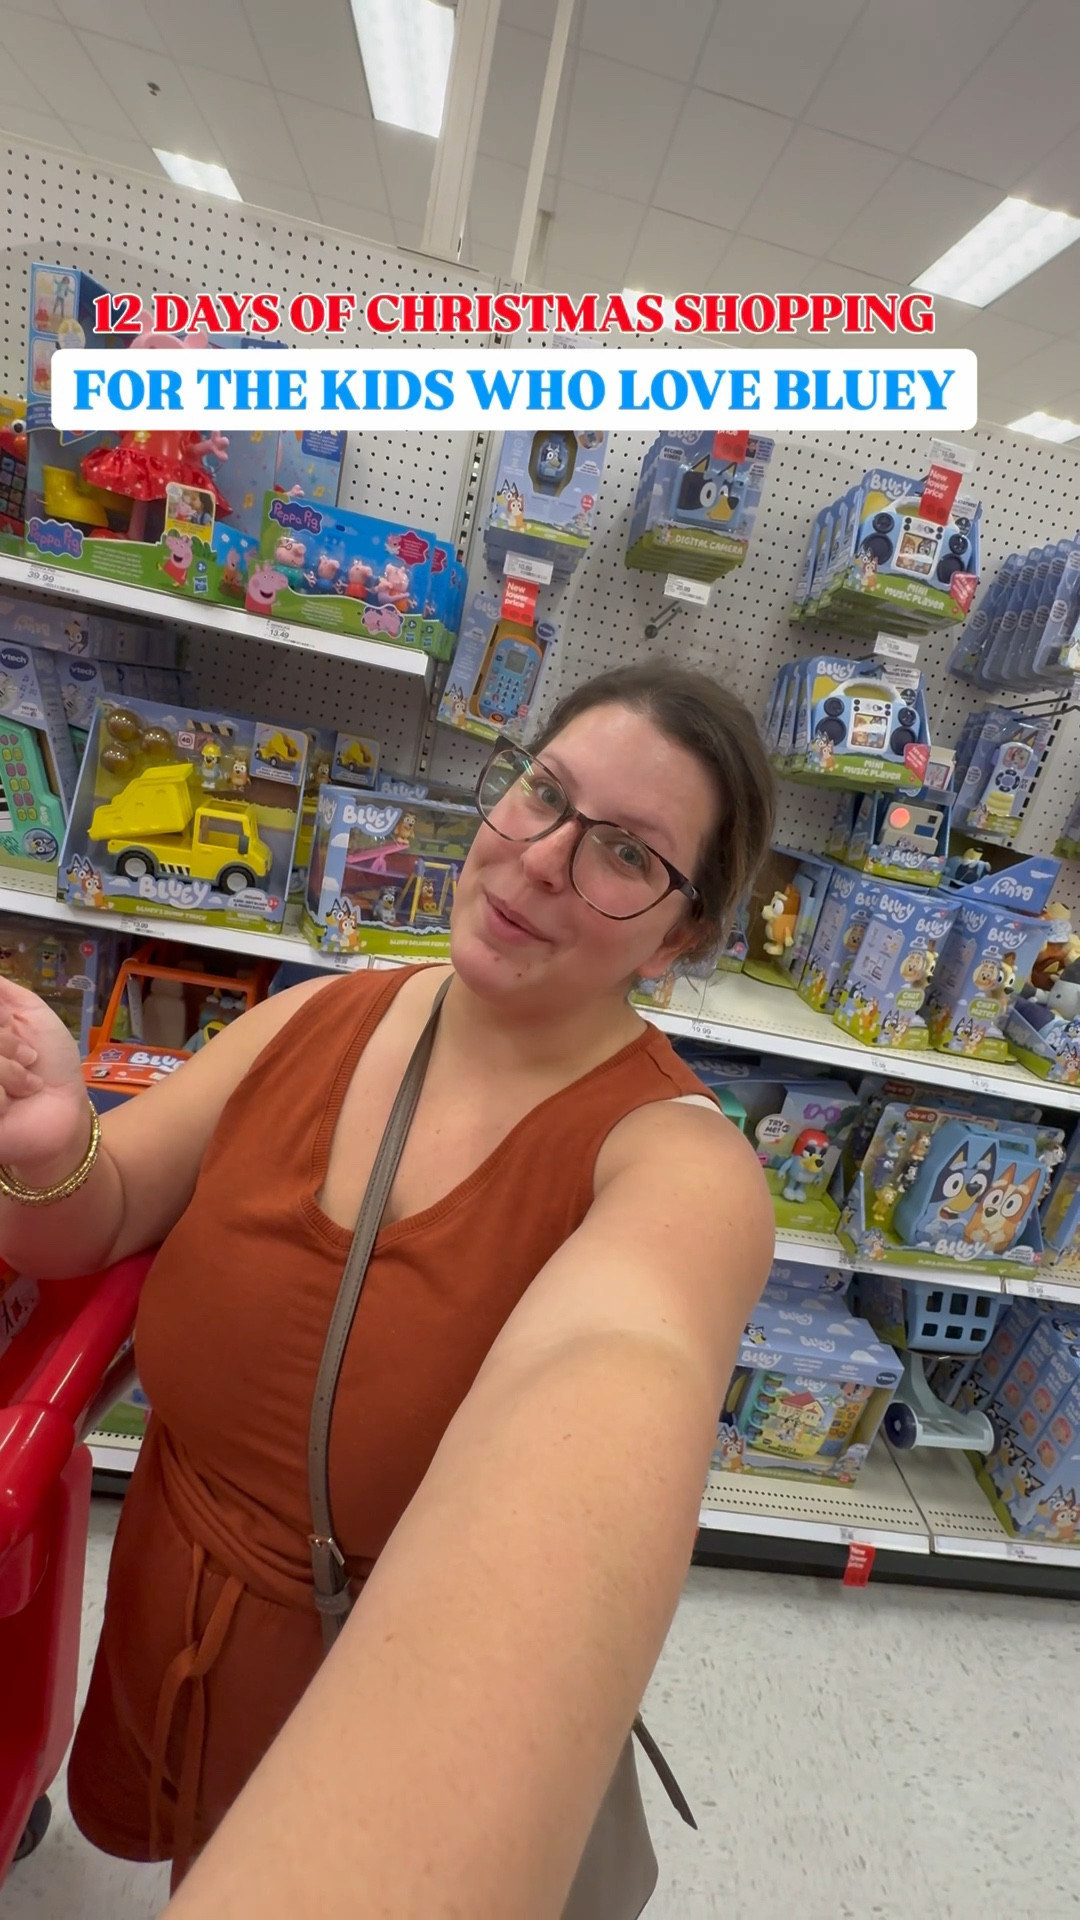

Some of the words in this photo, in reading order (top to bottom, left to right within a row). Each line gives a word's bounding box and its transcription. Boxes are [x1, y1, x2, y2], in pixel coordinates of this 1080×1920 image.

[929, 469, 949, 482] New
[927, 478, 949, 492] lower
[923, 487, 945, 500] price
[273, 503, 303, 524] Peppa
[303, 510, 320, 531] Pig
[28, 521, 62, 549] Peppa
[63, 527, 81, 553] Pig
[675, 533, 708, 549] DIGITAL
[709, 541, 744, 555] CAMERA
[27, 570, 55, 583] 39.99
[507, 581, 527, 594] New
[907, 583, 929, 596] MINI
[505, 590, 529, 602] lower
[885, 586, 912, 602] MUSIC
[911, 593, 945, 611] PLAYER
[504, 598, 525, 609] price
[270, 629, 290, 639] 13.49
[1, 652, 27, 665] vtech
[70, 665, 96, 677] vtech
[863, 759, 884, 769] MINI
[843, 765, 869, 777] MUSIC
[869, 768, 902, 781] PLAYER
[855, 892, 880, 907] BLU
[185, 913, 207, 921] TRUCK
[902, 991, 920, 1001] CHAT
[898, 999, 922, 1010] MATES
[976, 1001, 997, 1011] CHAT
[971, 1008, 997, 1018] MATES
[692, 1026, 712, 1035] 19.99
[130, 1052, 186, 1073] BLU
[906, 1111, 919, 1120] Only
[768, 1119, 783, 1127] TRY
[765, 1125, 781, 1134] ME!
[850, 1546, 866, 1556] New
[847, 1561, 864, 1570] price
[849, 1555, 868, 1565] lower
